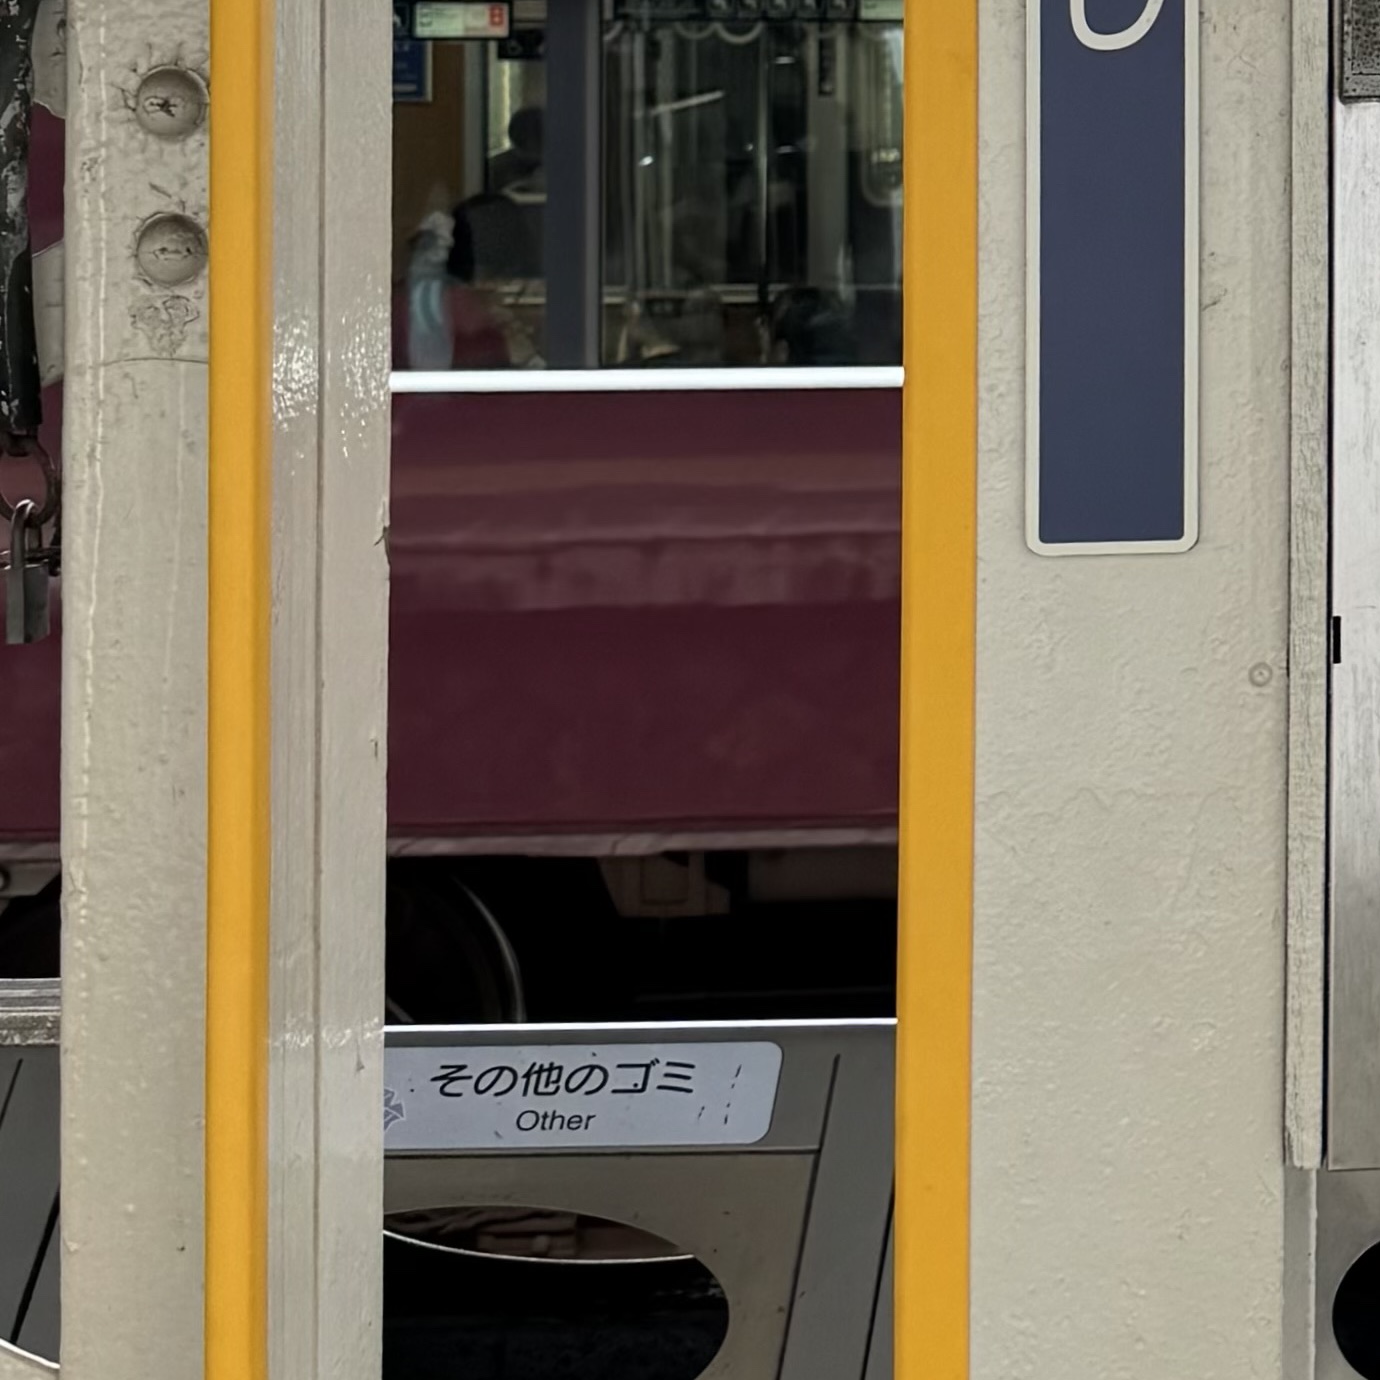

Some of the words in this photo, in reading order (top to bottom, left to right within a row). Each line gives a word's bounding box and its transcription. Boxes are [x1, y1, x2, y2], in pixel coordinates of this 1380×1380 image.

[430, 1058, 696, 1098] その他のゴミ
[515, 1109, 597, 1132] Other
